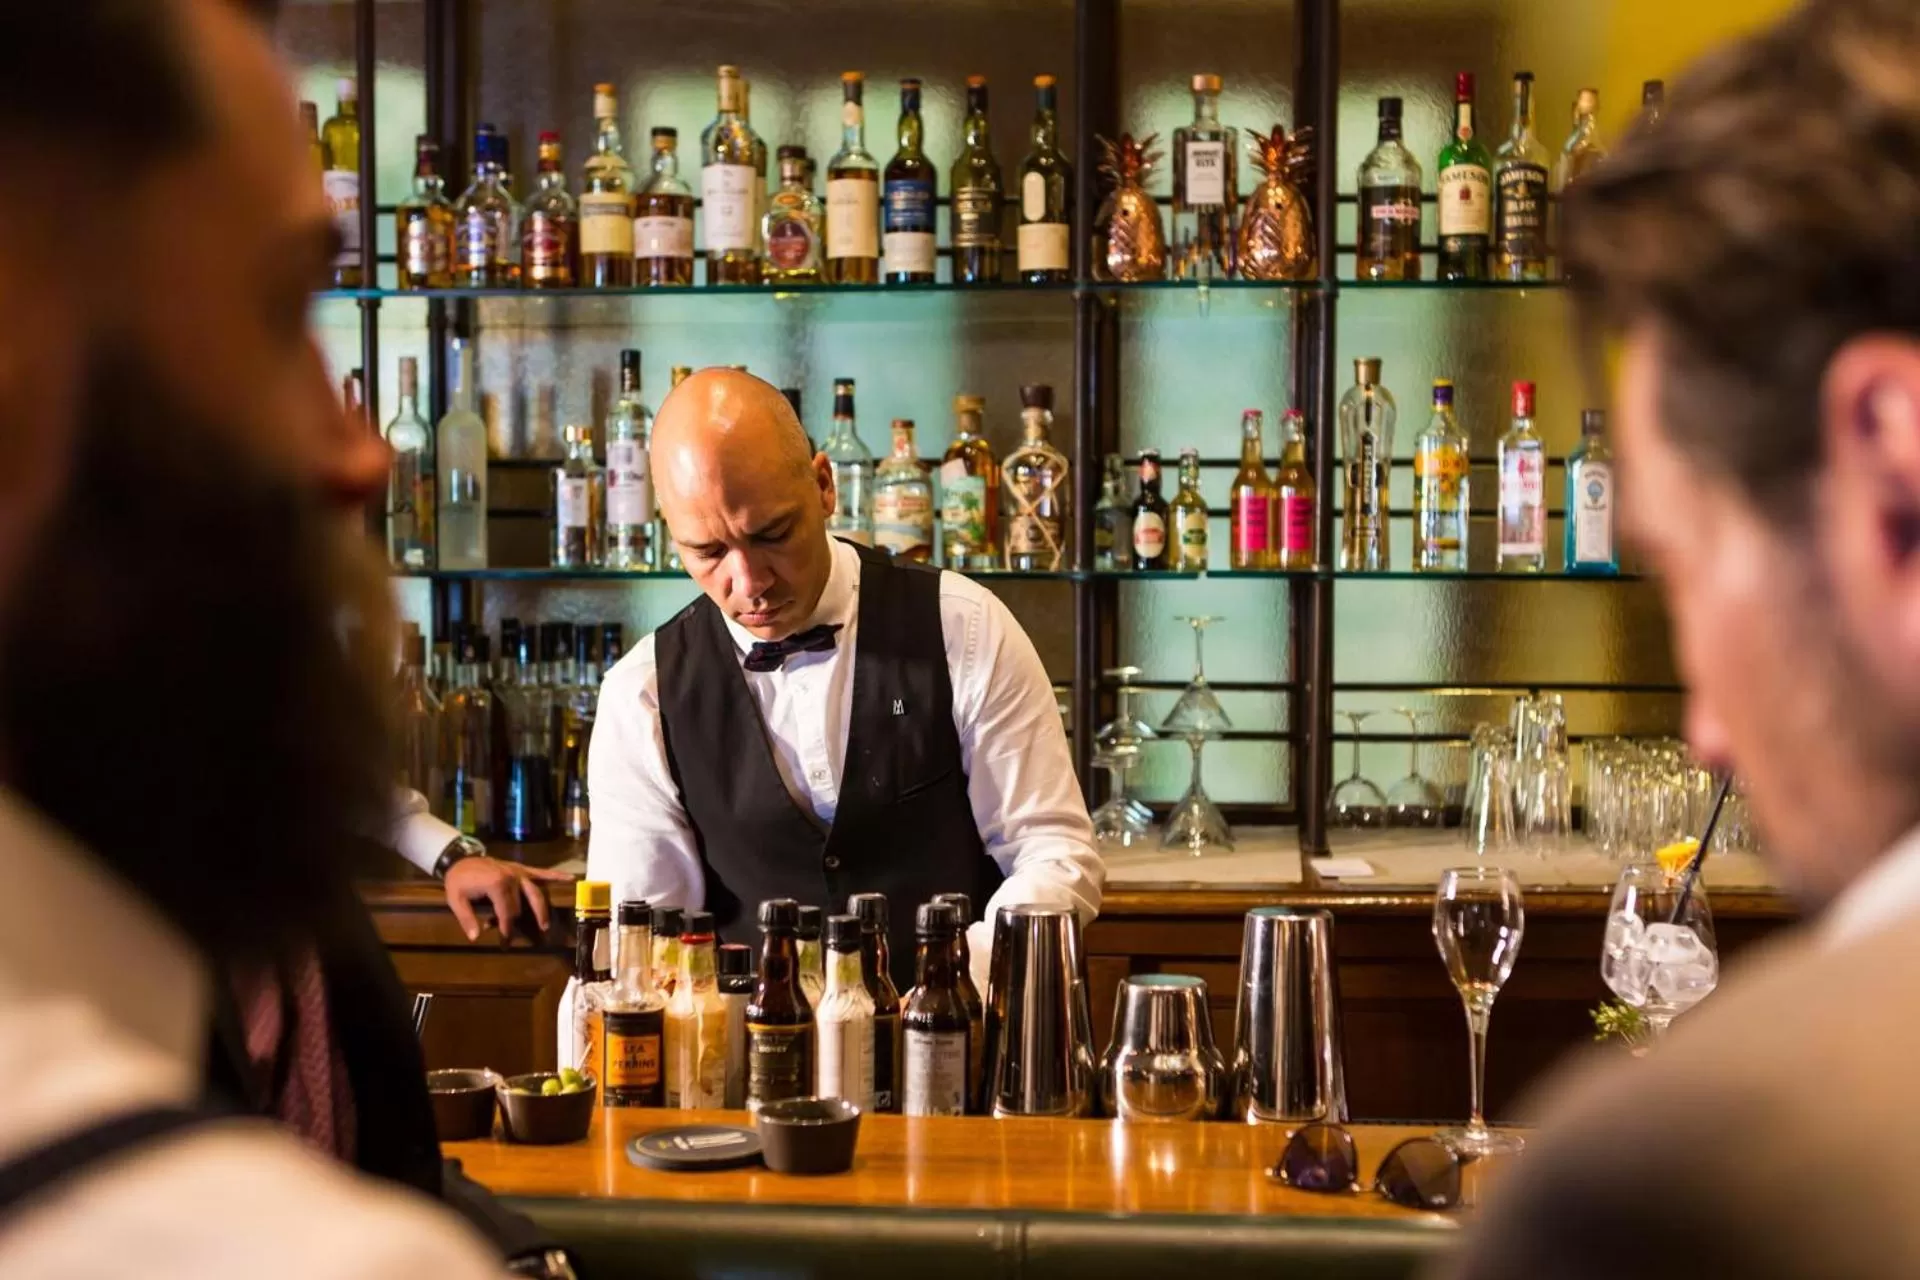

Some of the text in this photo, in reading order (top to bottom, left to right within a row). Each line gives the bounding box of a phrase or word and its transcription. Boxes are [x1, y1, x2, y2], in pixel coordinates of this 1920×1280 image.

[1440, 169, 1489, 185] JAMESON
[1500, 169, 1545, 185] JAMESON
[623, 1043, 645, 1053] LEA
[612, 1059, 656, 1070] PERRINS
